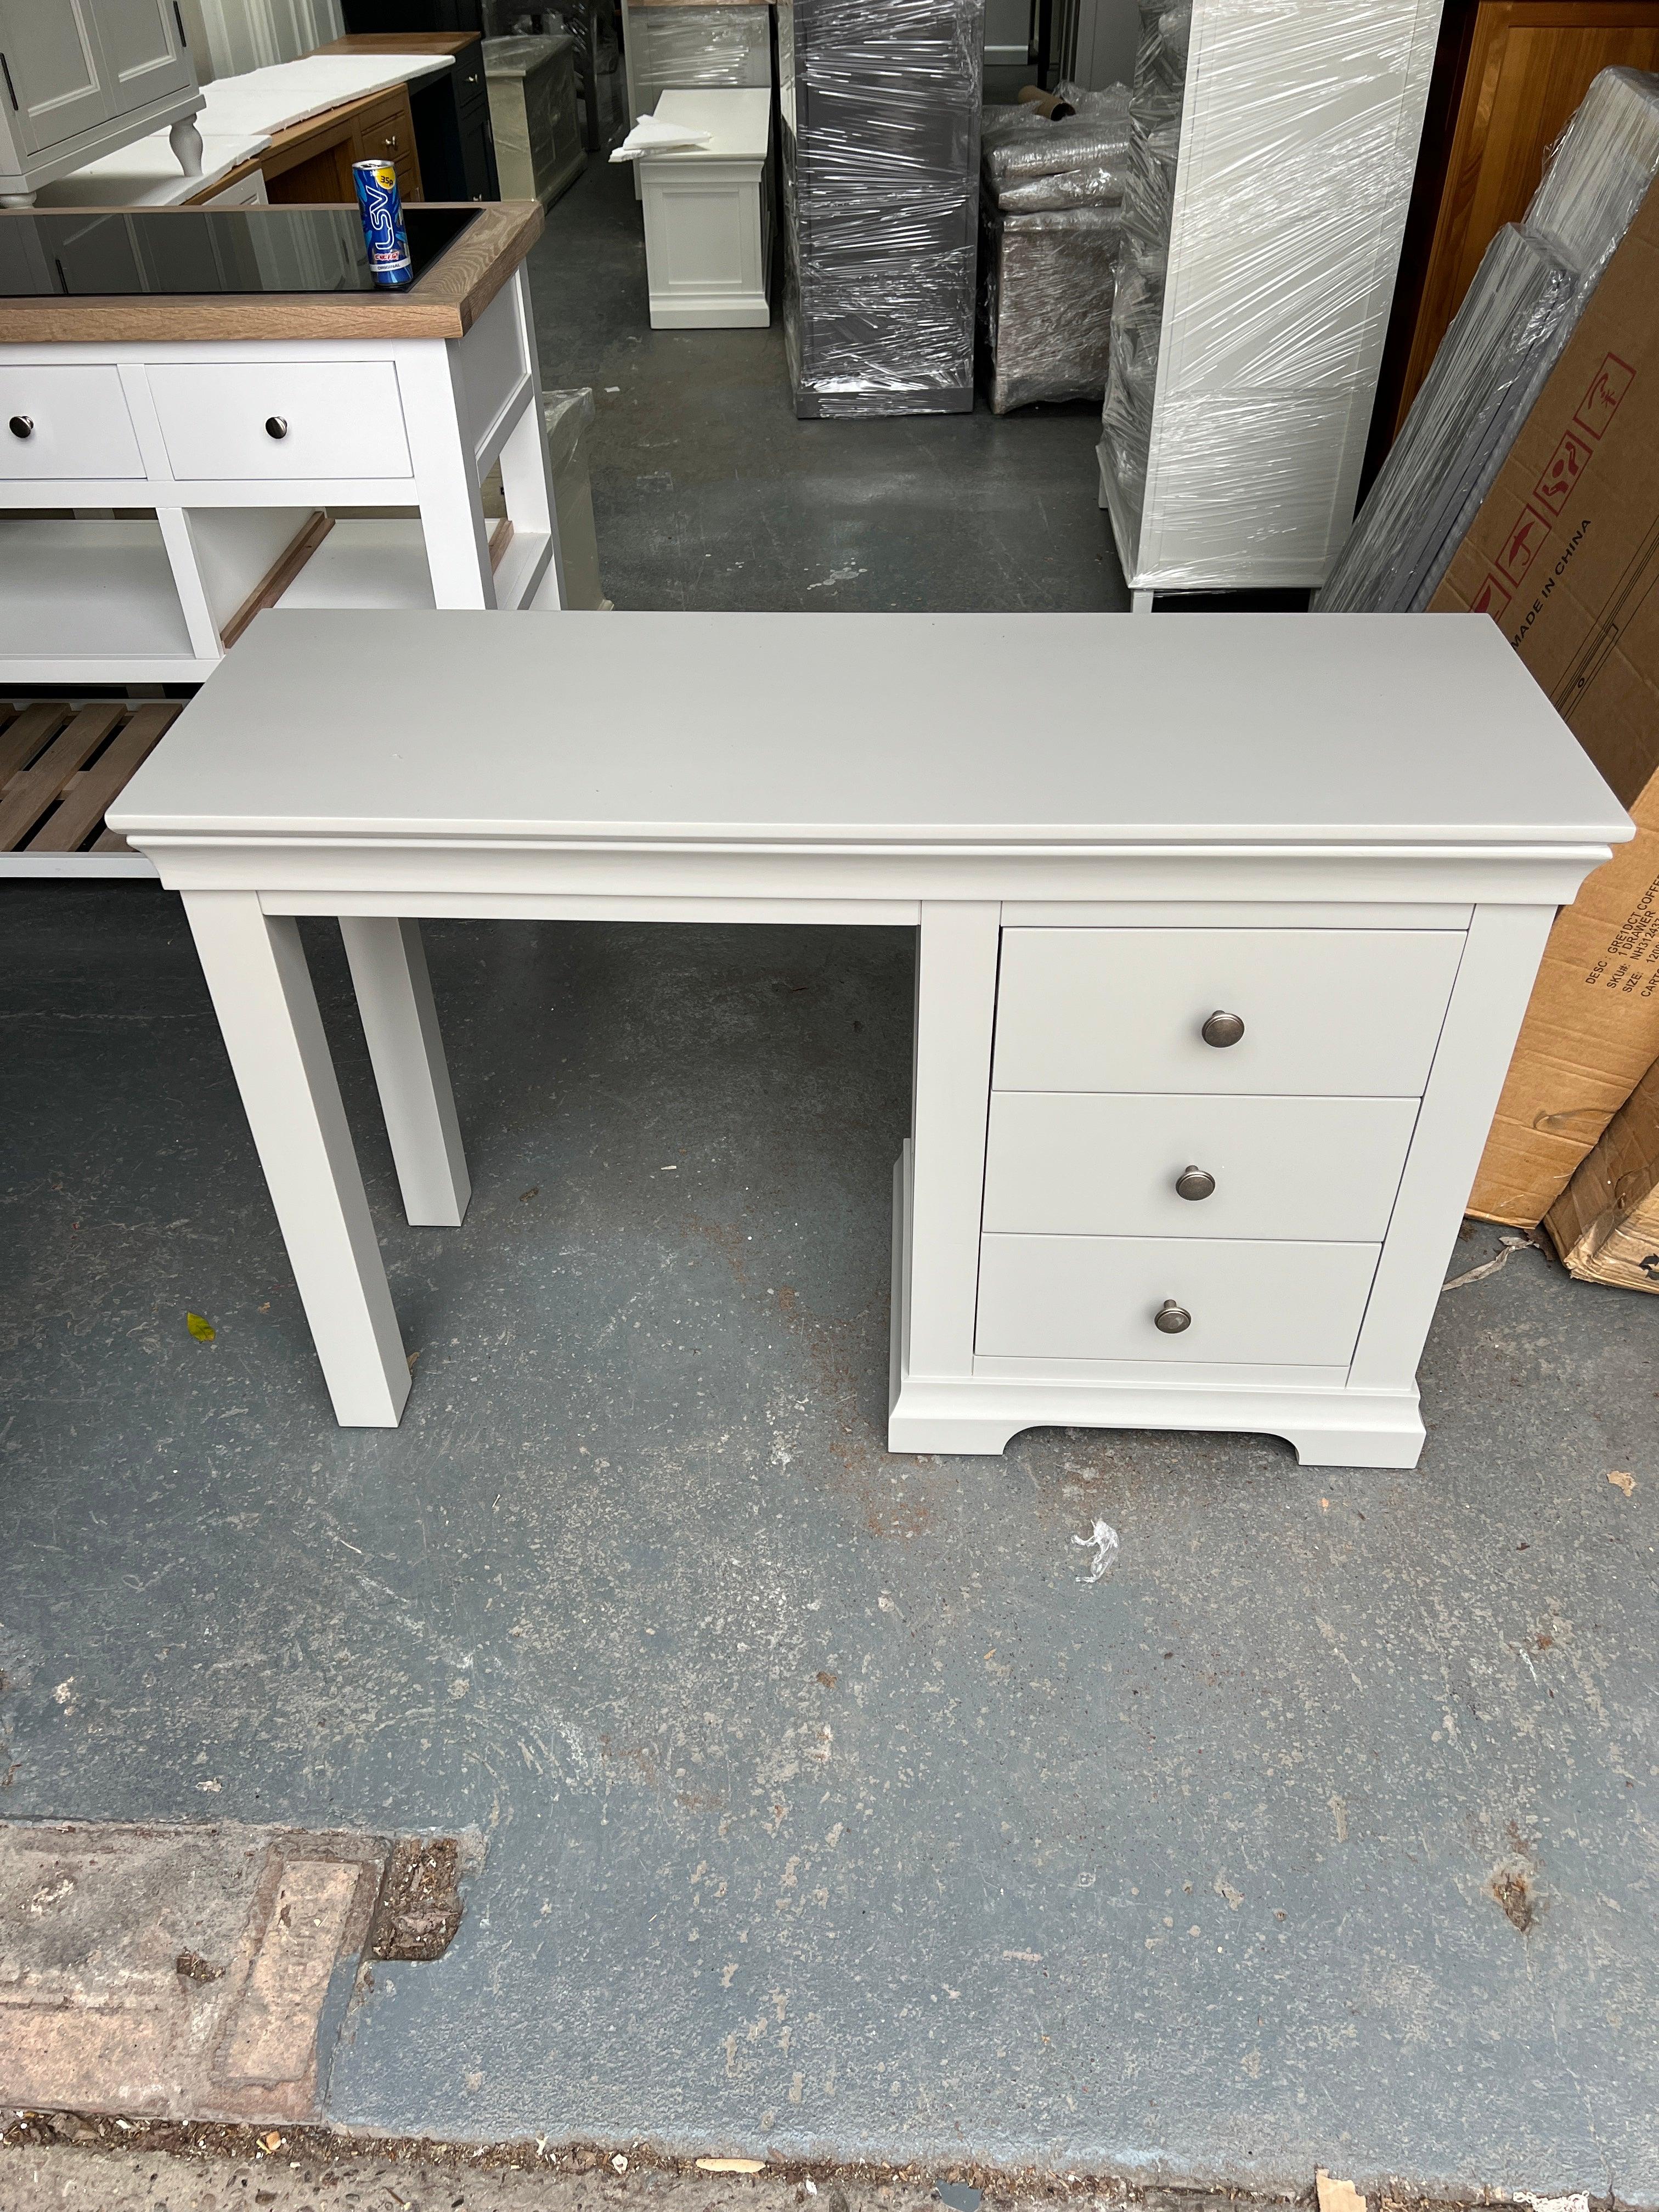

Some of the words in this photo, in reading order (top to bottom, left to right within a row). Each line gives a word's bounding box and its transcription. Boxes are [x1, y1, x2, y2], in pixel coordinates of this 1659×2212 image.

[380, 176, 393, 187] 35p
[365, 185, 394, 250] LSV
[1511, 599, 1543, 651] MADE
[1542, 578, 1555, 598] IN
[1555, 520, 1591, 575] CHINA
[1607, 911, 1641, 953] GRE1DCT
[1637, 874, 1659, 910] COFFE
[1622, 911, 1656, 950] DRAWER
[1622, 972, 1644, 992] SIZE:
